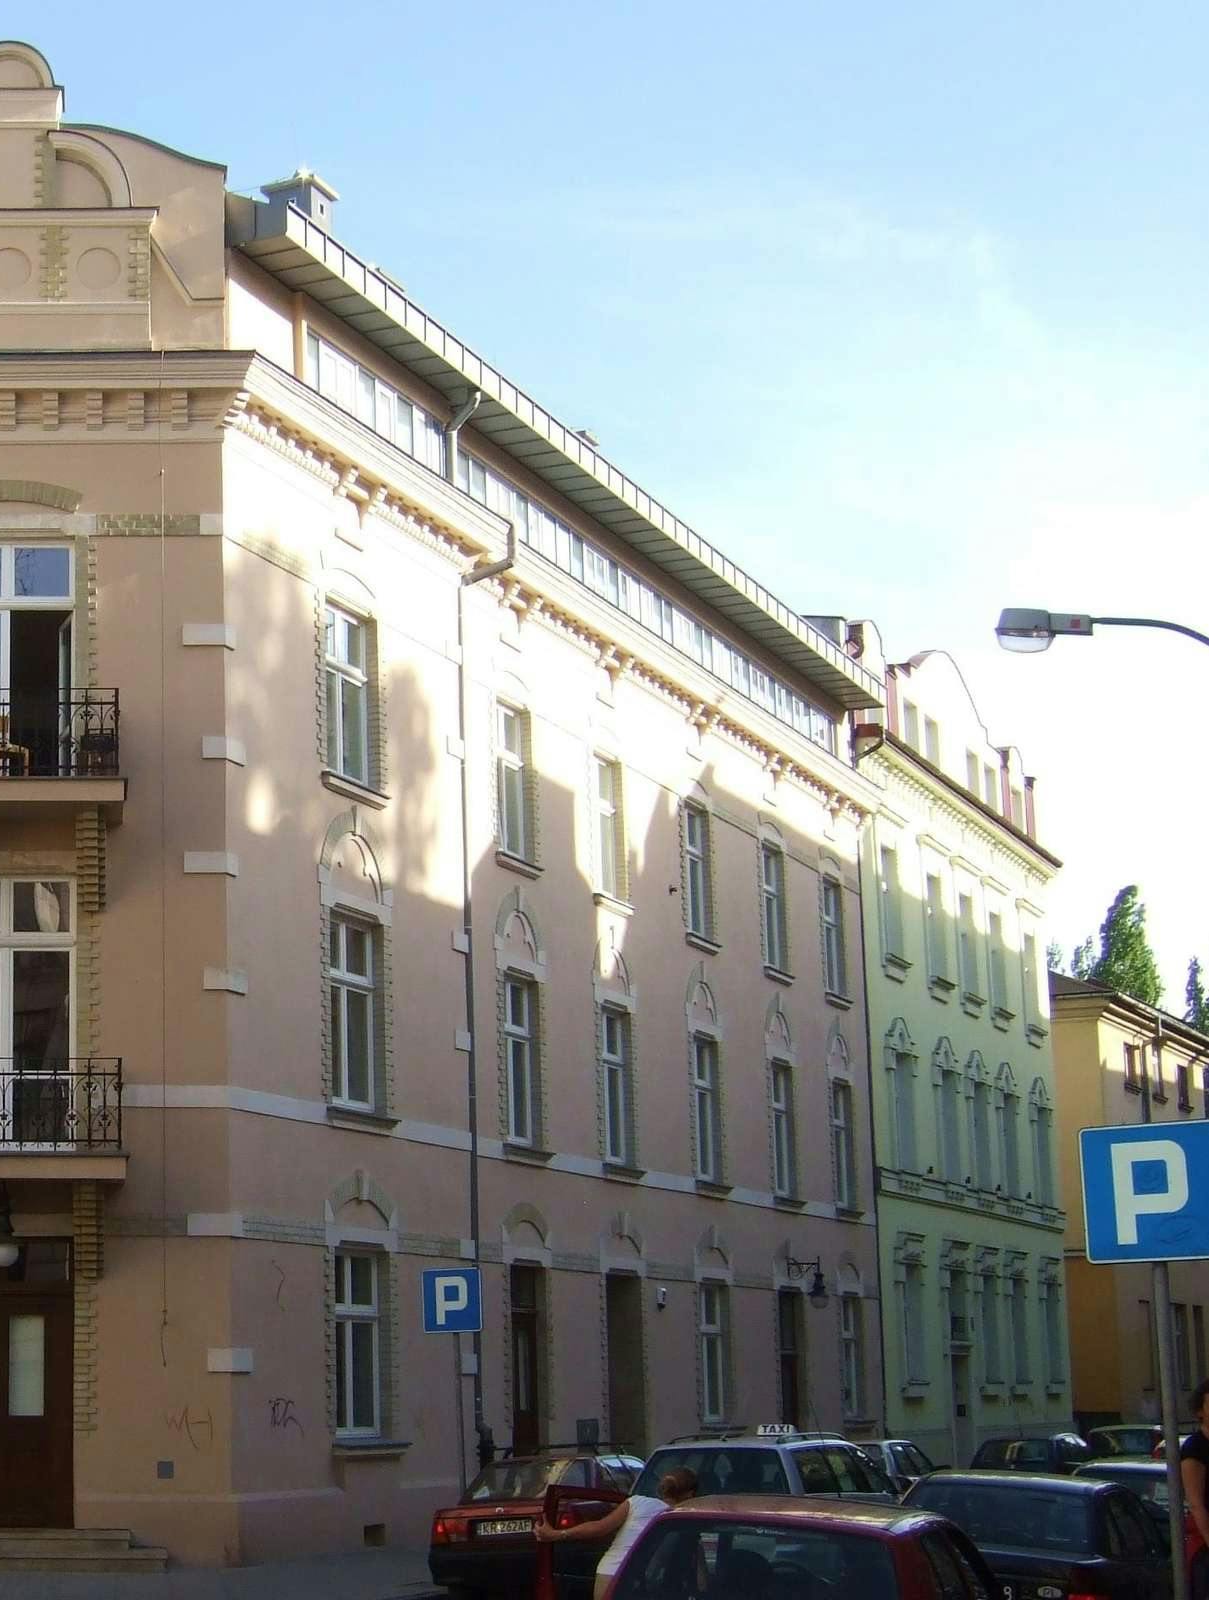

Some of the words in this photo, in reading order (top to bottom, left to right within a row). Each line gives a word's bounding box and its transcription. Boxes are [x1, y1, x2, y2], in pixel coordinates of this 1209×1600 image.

[1110, 1139, 1189, 1246] P
[435, 1276, 468, 1325] P
[762, 1425, 790, 1433] TAXI
